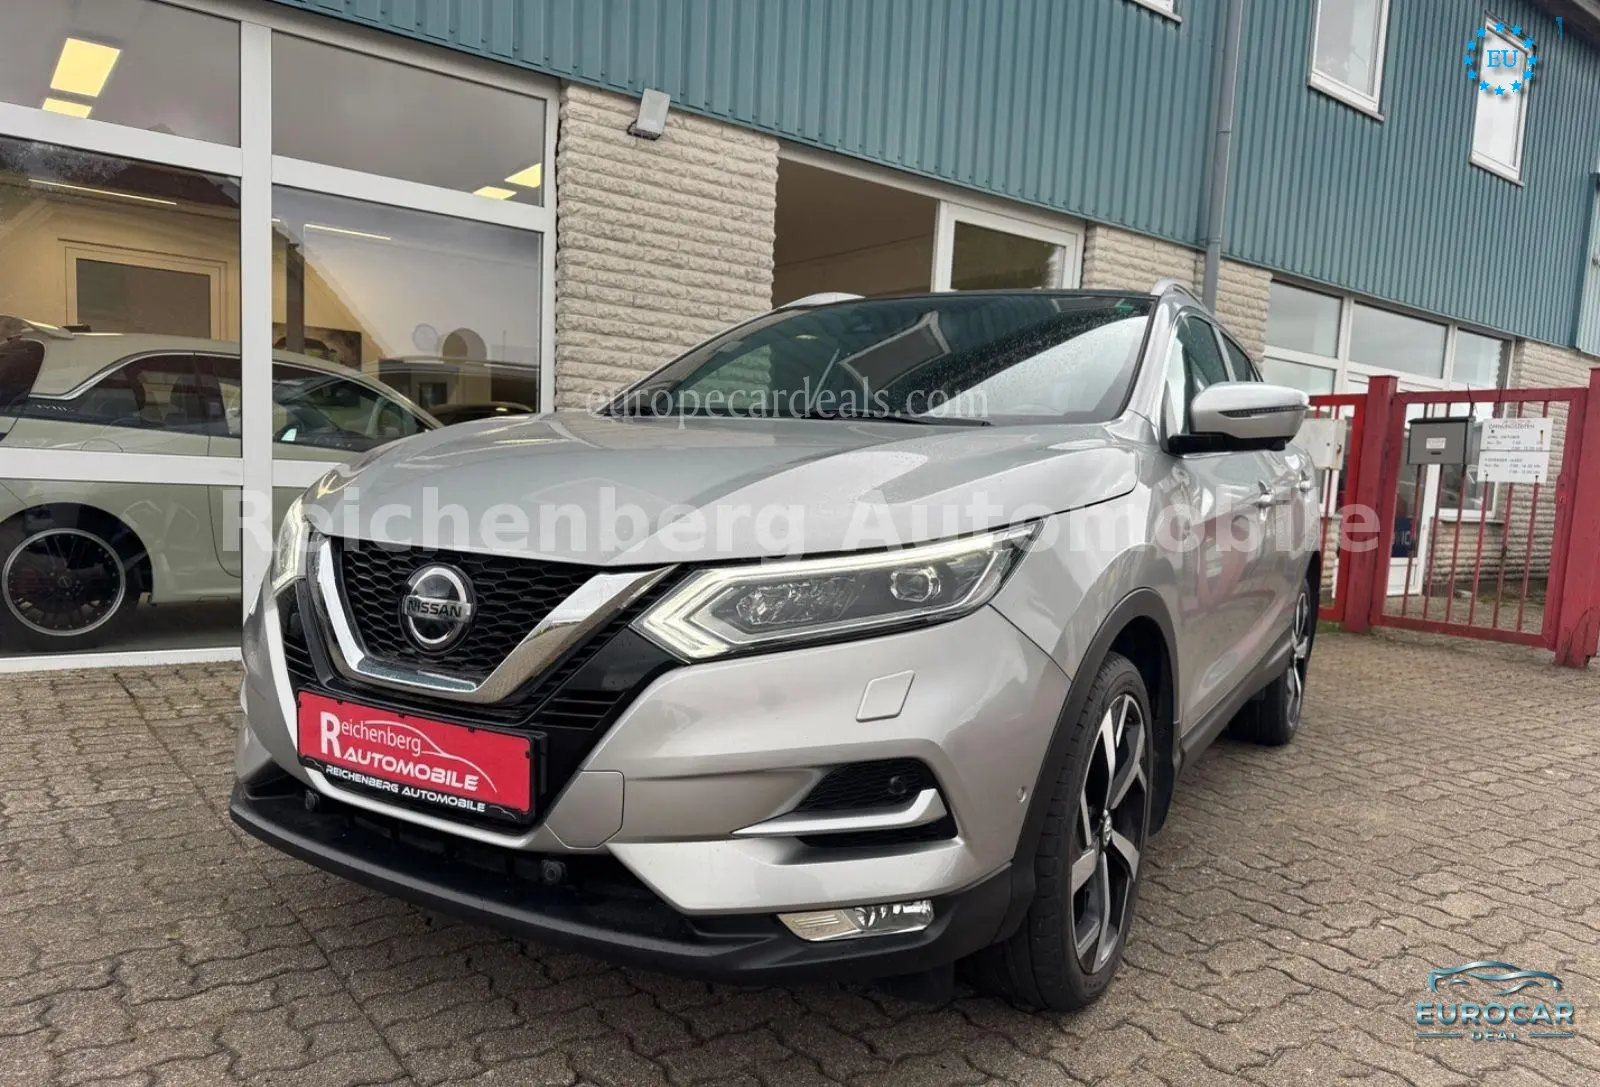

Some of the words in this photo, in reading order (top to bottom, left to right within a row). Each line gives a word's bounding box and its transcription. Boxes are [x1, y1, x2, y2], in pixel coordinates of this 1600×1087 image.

[408, 600, 462, 618] NISSAN
[319, 711, 422, 758] Reichenberg
[325, 764, 400, 793] REICHENBERG
[401, 786, 486, 813] AUTOMOBILE
[342, 748, 480, 792] AUTOMOBILE
